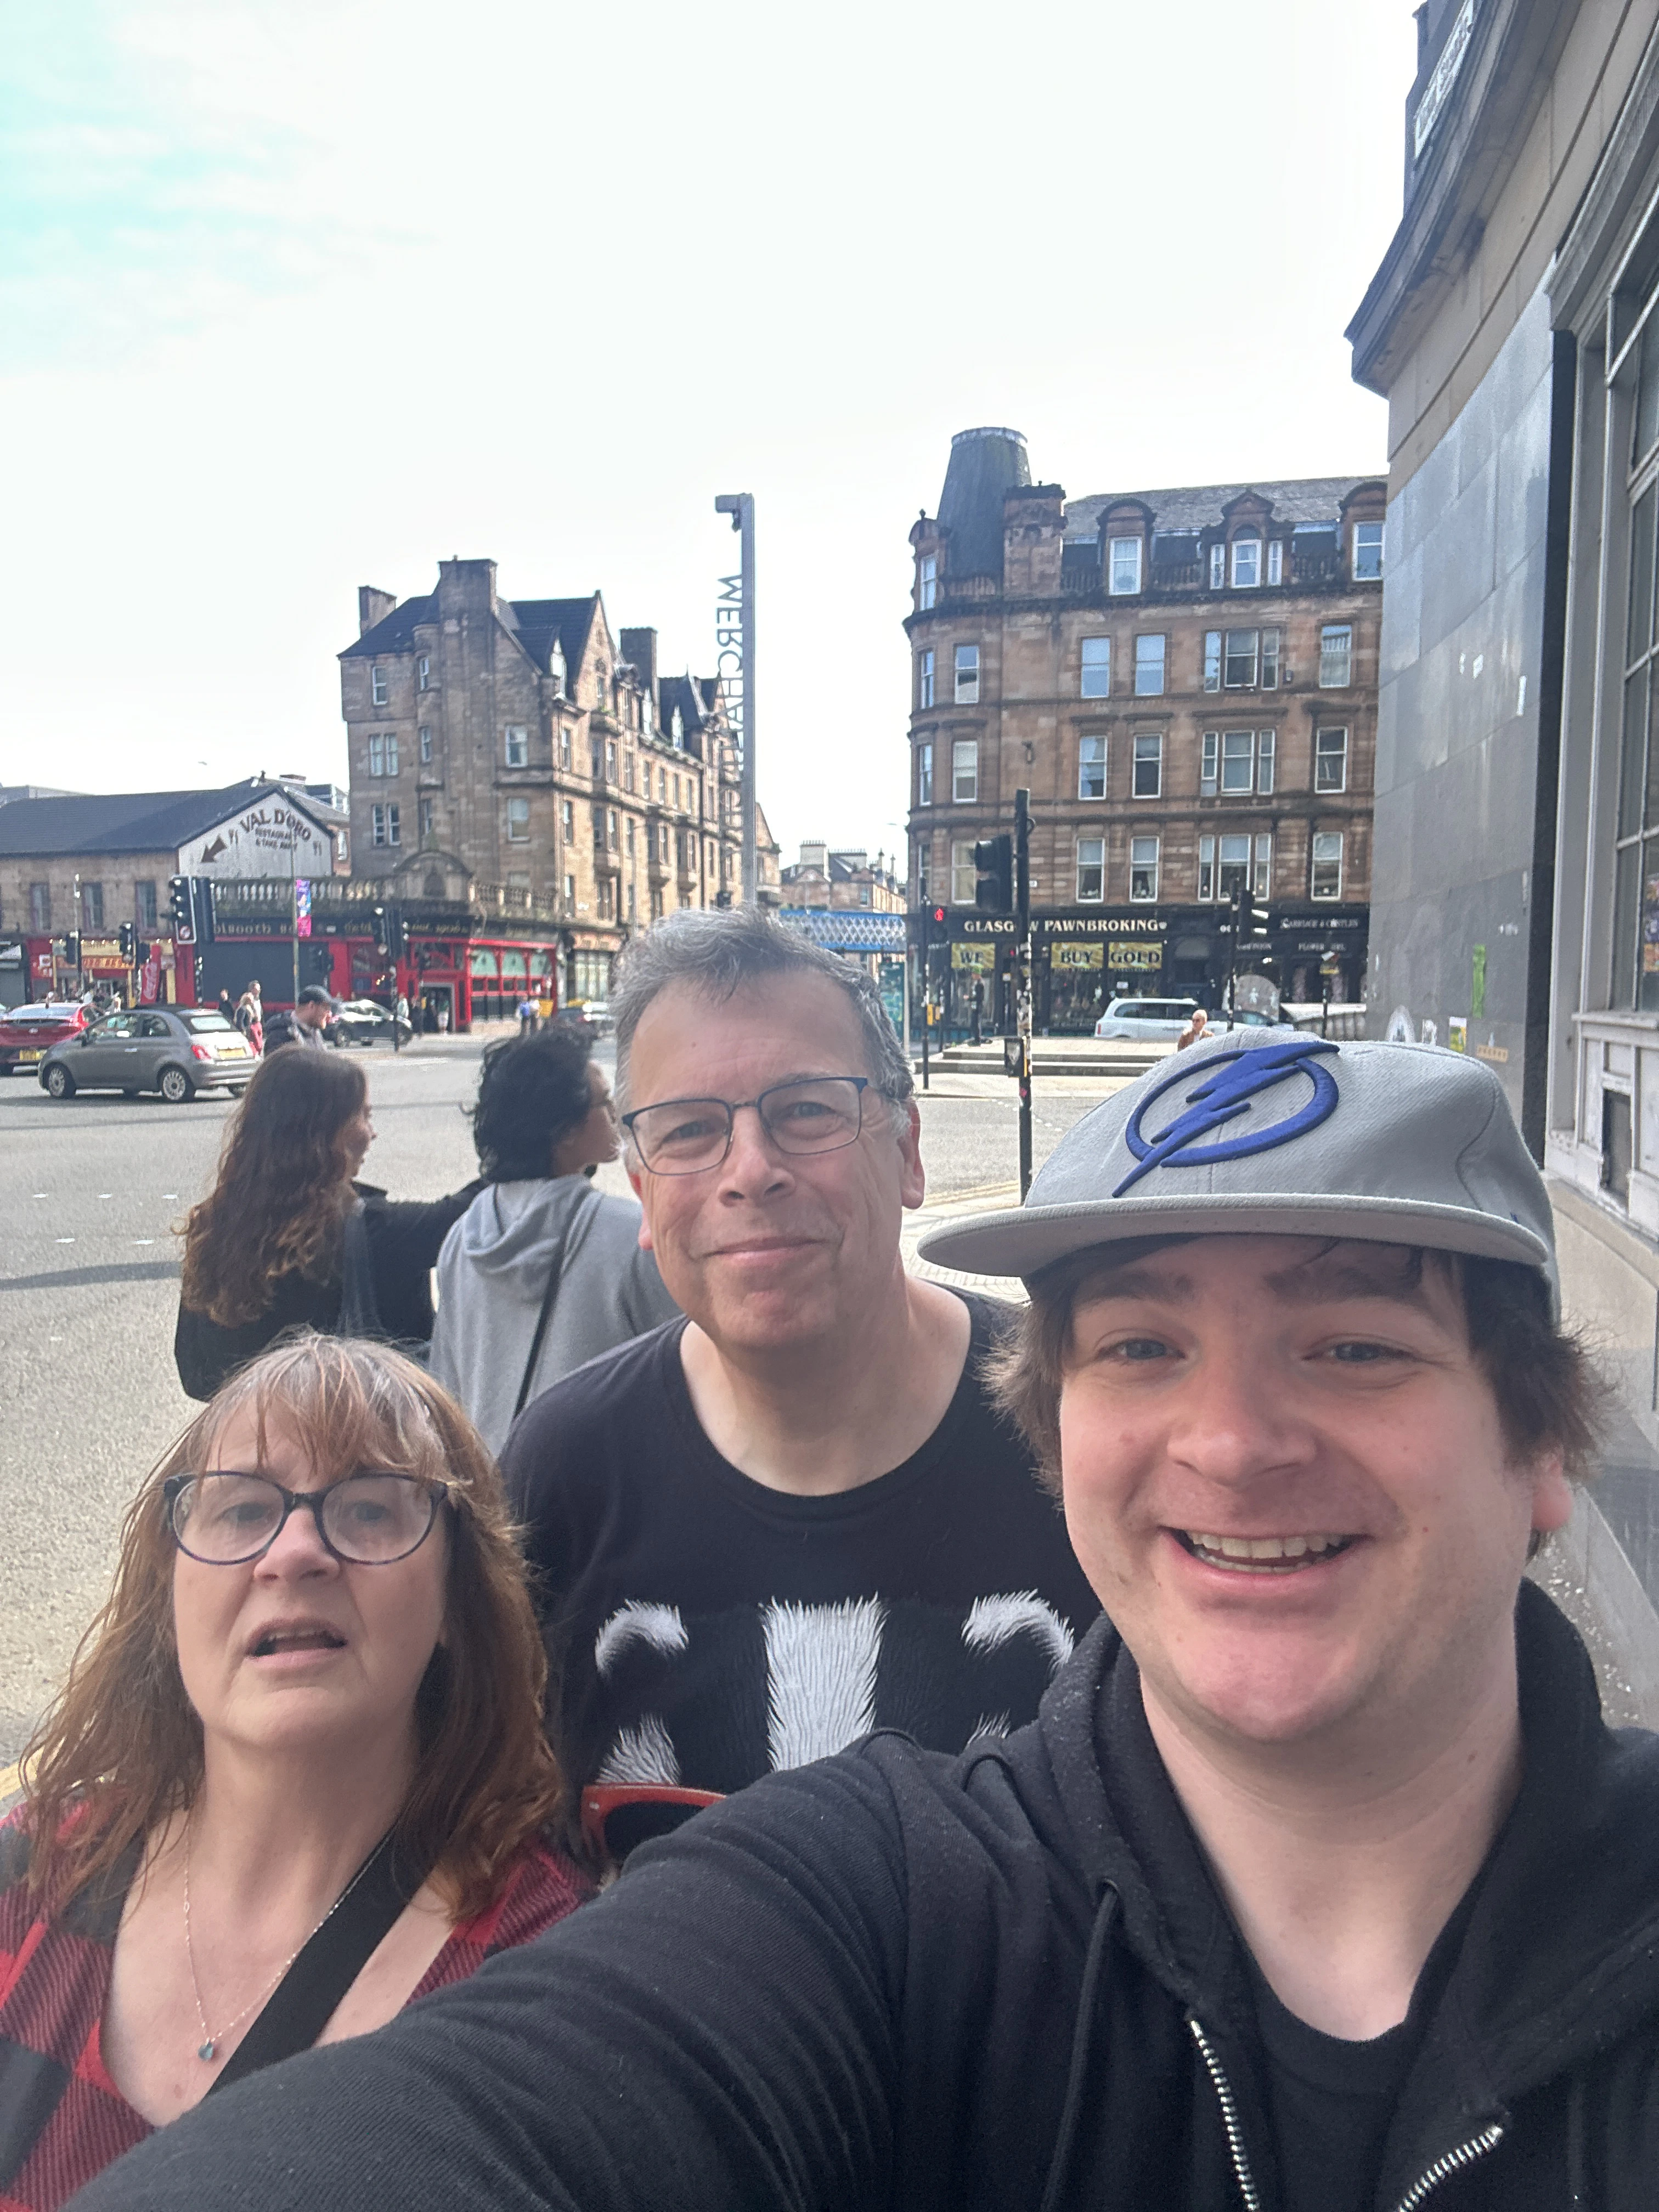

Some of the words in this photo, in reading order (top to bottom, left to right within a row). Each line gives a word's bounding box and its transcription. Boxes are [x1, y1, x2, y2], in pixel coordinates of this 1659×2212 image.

[240, 809, 271, 833] VAL
[274, 808, 311, 842] D'ORO
[1045, 919, 1158, 932] PAWNBROKING
[960, 951, 984, 964] WE
[1060, 950, 1093, 964] BUY
[1110, 950, 1160, 964] GOLD
